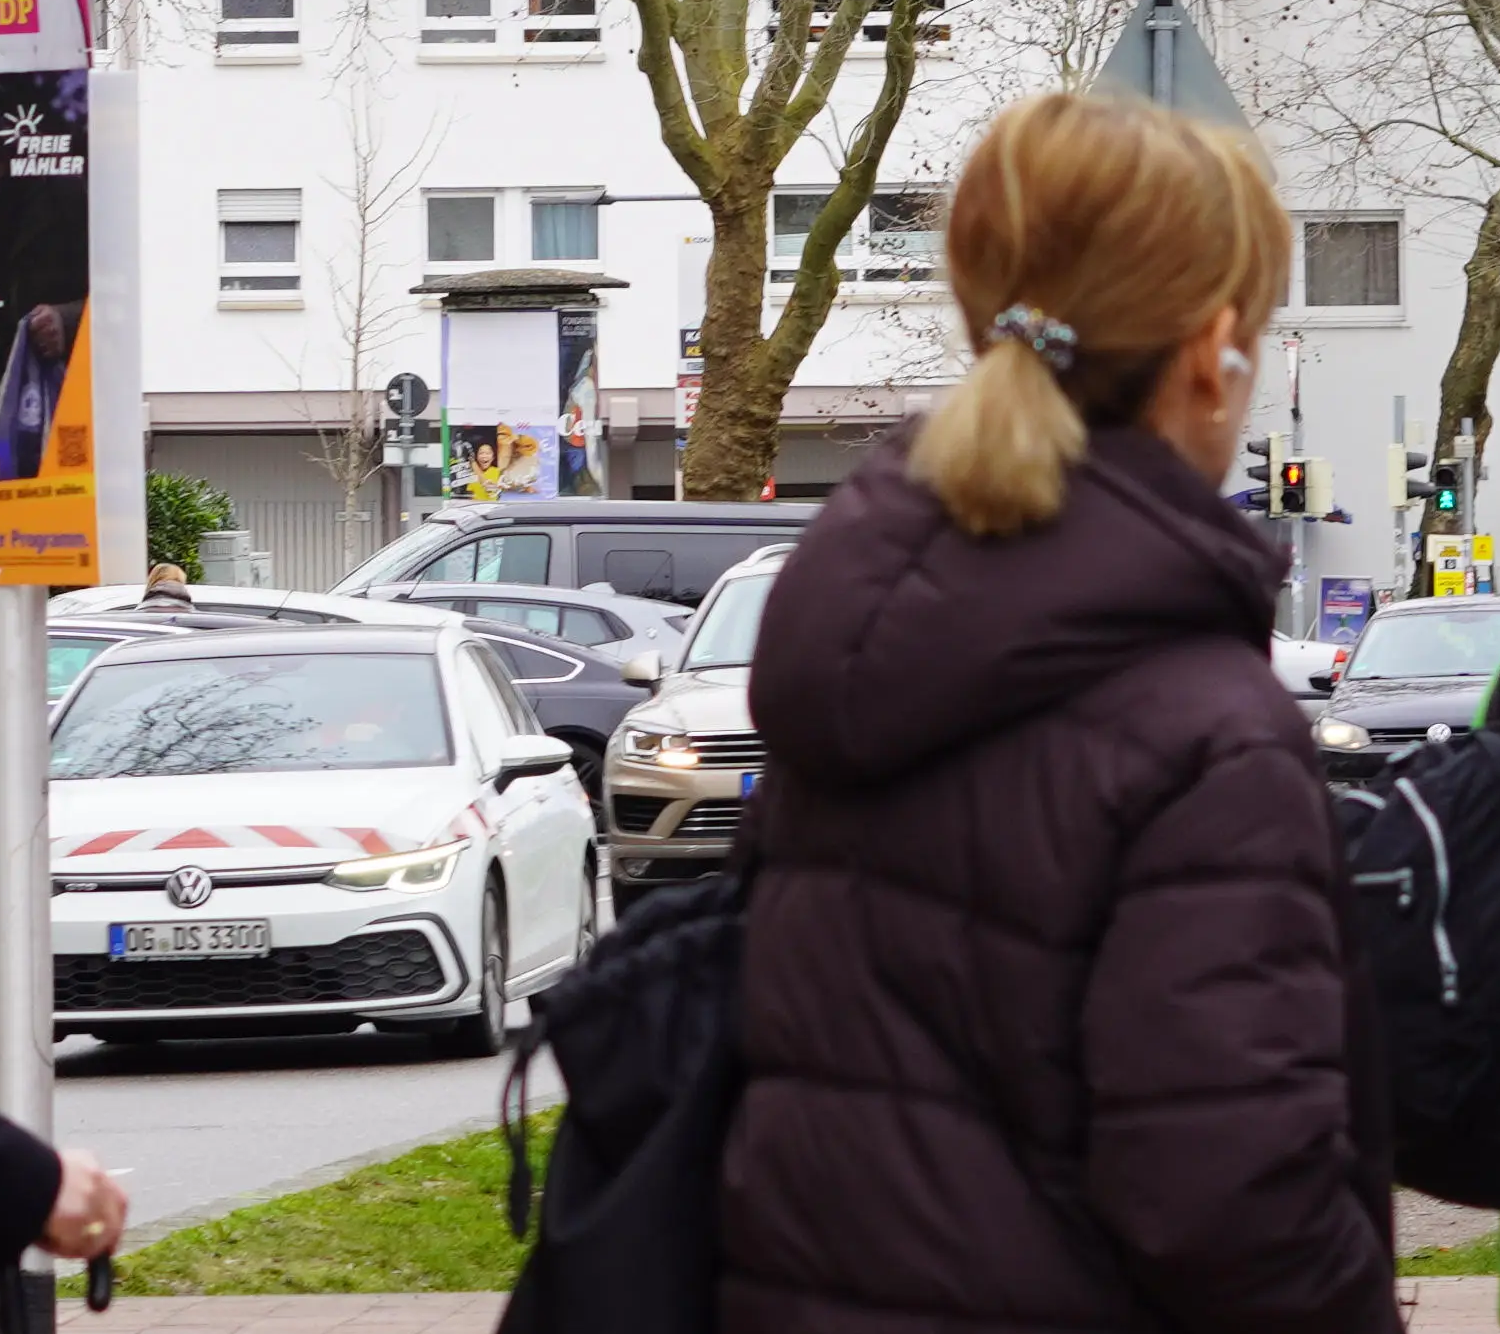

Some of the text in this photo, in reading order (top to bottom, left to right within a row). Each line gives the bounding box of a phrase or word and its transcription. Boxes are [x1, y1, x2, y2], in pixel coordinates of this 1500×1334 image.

[17, 135, 71, 154] FREIE
[10, 153, 84, 175] WÄHLER
[127, 924, 266, 952] OG DS 3300
